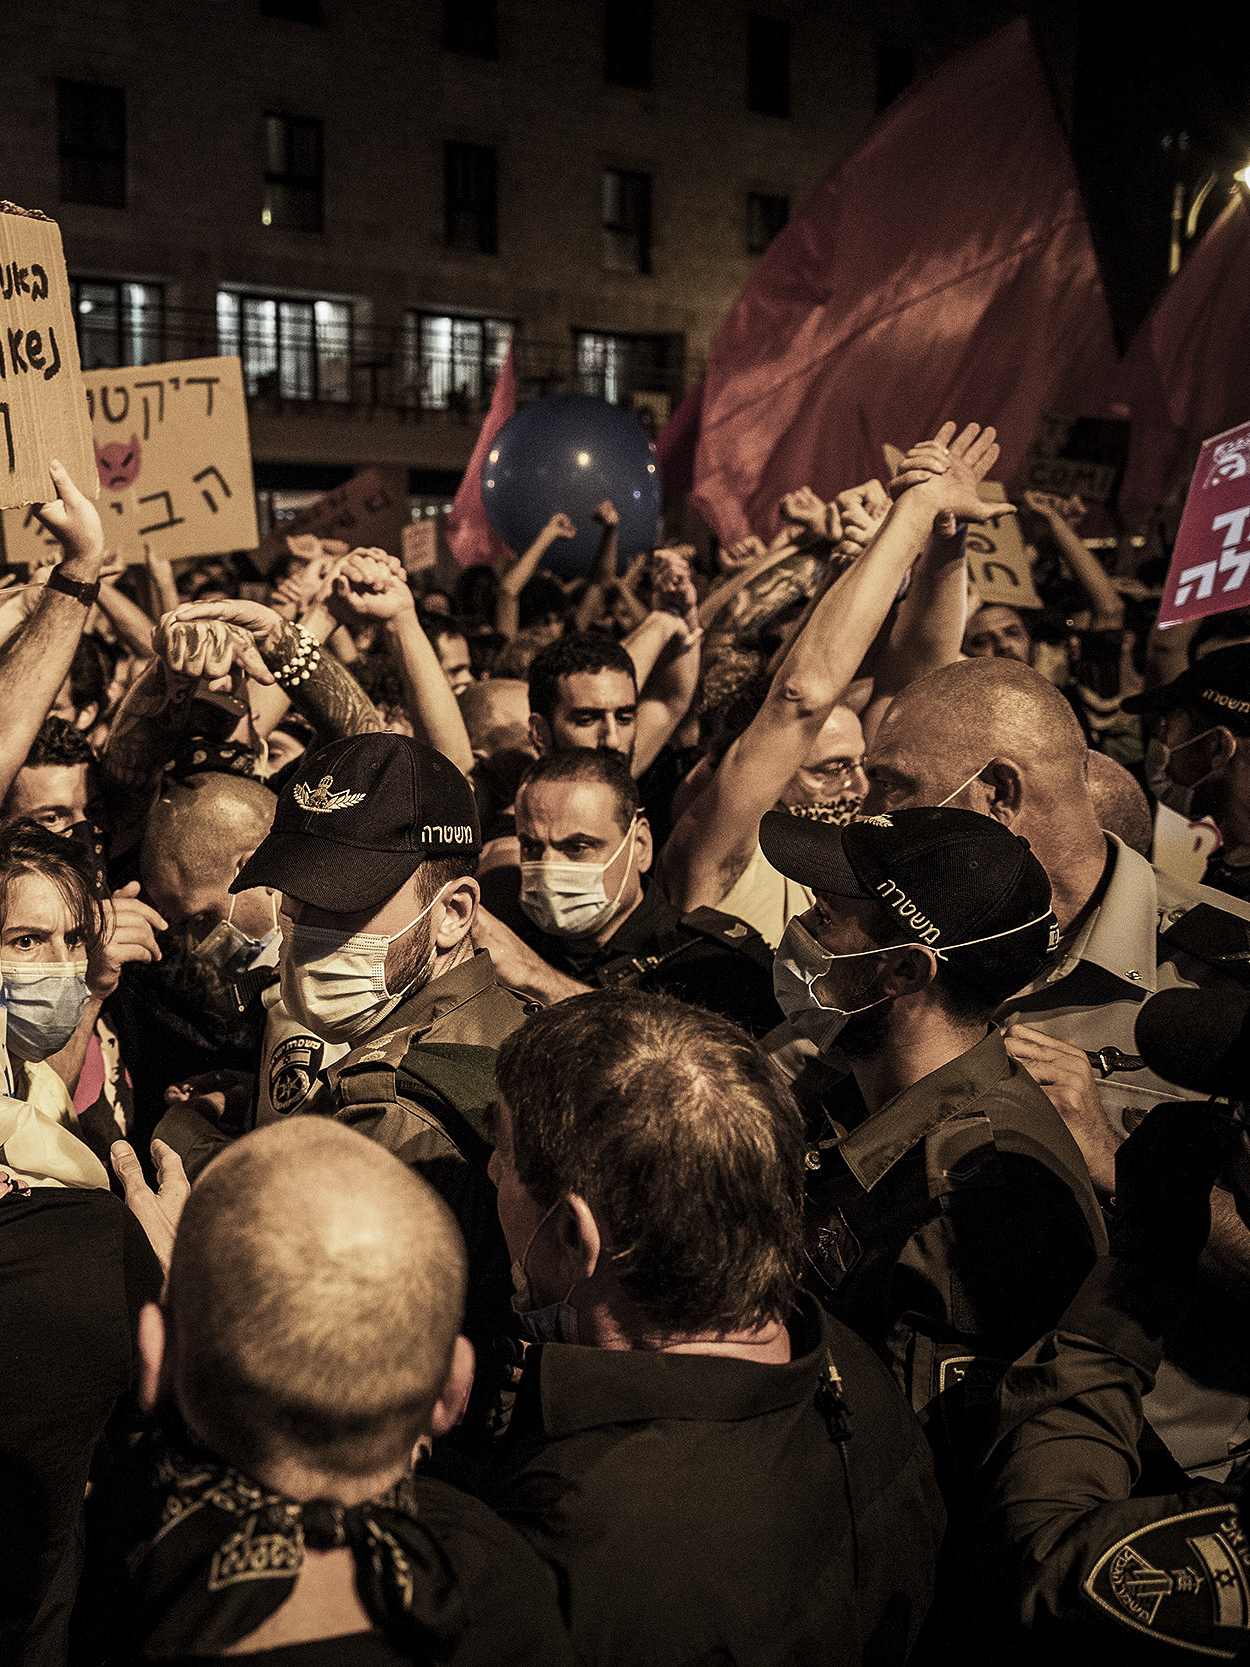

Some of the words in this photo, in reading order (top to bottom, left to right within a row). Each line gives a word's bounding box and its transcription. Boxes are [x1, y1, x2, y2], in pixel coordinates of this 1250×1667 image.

[1202, 688, 1250, 713] משטרה
[421, 825, 473, 844] משטרה
[876, 879, 941, 945] משטרה
